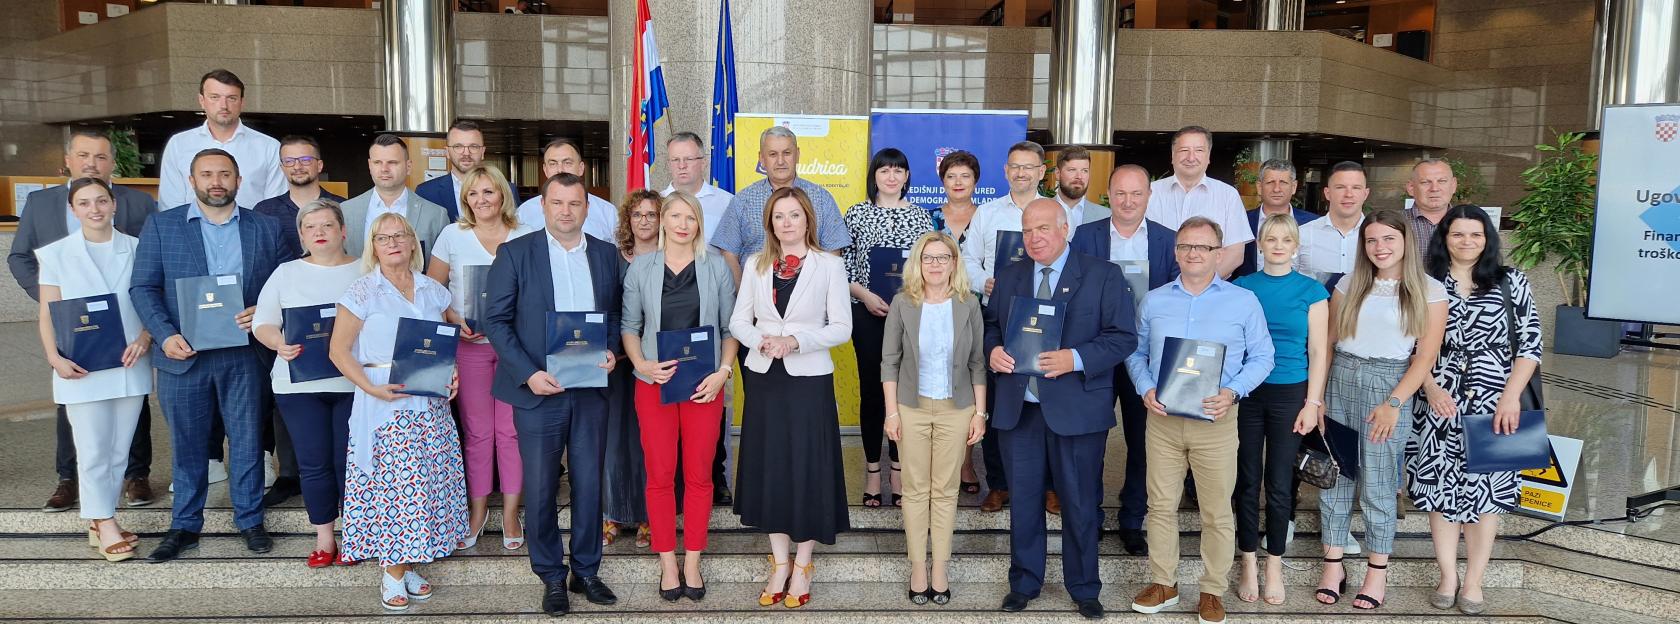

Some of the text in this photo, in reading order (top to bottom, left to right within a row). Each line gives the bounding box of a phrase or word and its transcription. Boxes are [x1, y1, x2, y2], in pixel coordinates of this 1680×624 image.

[796, 158, 848, 175] udrica
[907, 185, 938, 194] EDIŠNJI
[974, 187, 996, 195] URED
[910, 196, 949, 204] DEMOGRA
[1525, 490, 1541, 499] PAZI
[1521, 496, 1553, 508] EPENICE
